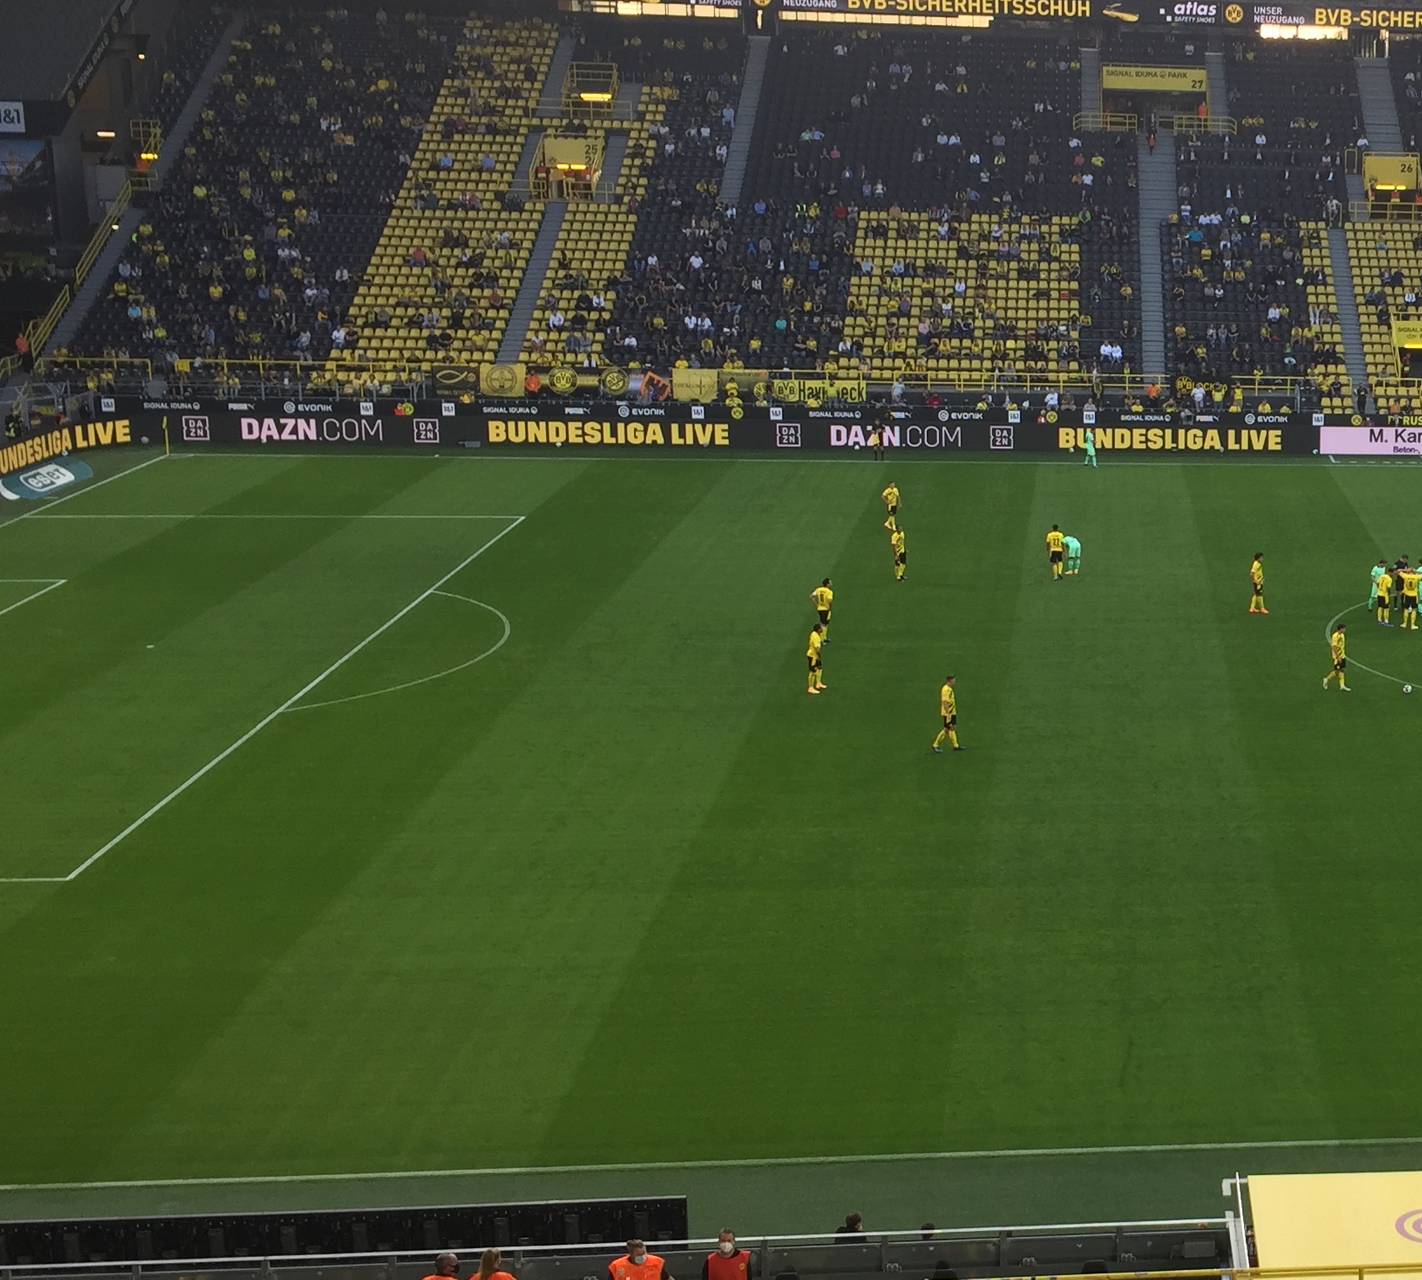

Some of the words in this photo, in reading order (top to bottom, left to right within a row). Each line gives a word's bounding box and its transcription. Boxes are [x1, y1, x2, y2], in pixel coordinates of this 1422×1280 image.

[848, 0, 1090, 16] BVB-SICHERHEITSSCHUH
[1173, 2, 1216, 16] atlas
[1254, 7, 1283, 15] UNSER
[1254, 15, 1305, 24] NEUZUGANG
[1191, 80, 1204, 89] 27
[0, 109, 21, 124] &1
[584, 144, 598, 155] 25
[1400, 163, 1413, 173] 26
[778, 381, 795, 395] BVB
[798, 380, 865, 402] Havieck
[632, 407, 665, 415] EVONIK
[951, 412, 984, 420] EVONIK
[1257, 415, 1288, 423] EVONIK
[187, 419, 204, 428] DA
[190, 428, 204, 437] ZN
[241, 418, 383, 441] DAZN.COM
[488, 420, 665, 444] BUNDESLIGA
[671, 423, 729, 446] LIVE
[782, 427, 795, 435] DA
[75, 420, 131, 450] LIVE
[420, 431, 434, 439] ZN
[782, 435, 795, 443] ZN
[830, 424, 961, 447] DAN.COM
[1228, 429, 1282, 450] LIVE
[1369, 430, 1388, 443] M.
[995, 437, 1008, 445] ZN
[1393, 446, 1420, 454] Beton-,
